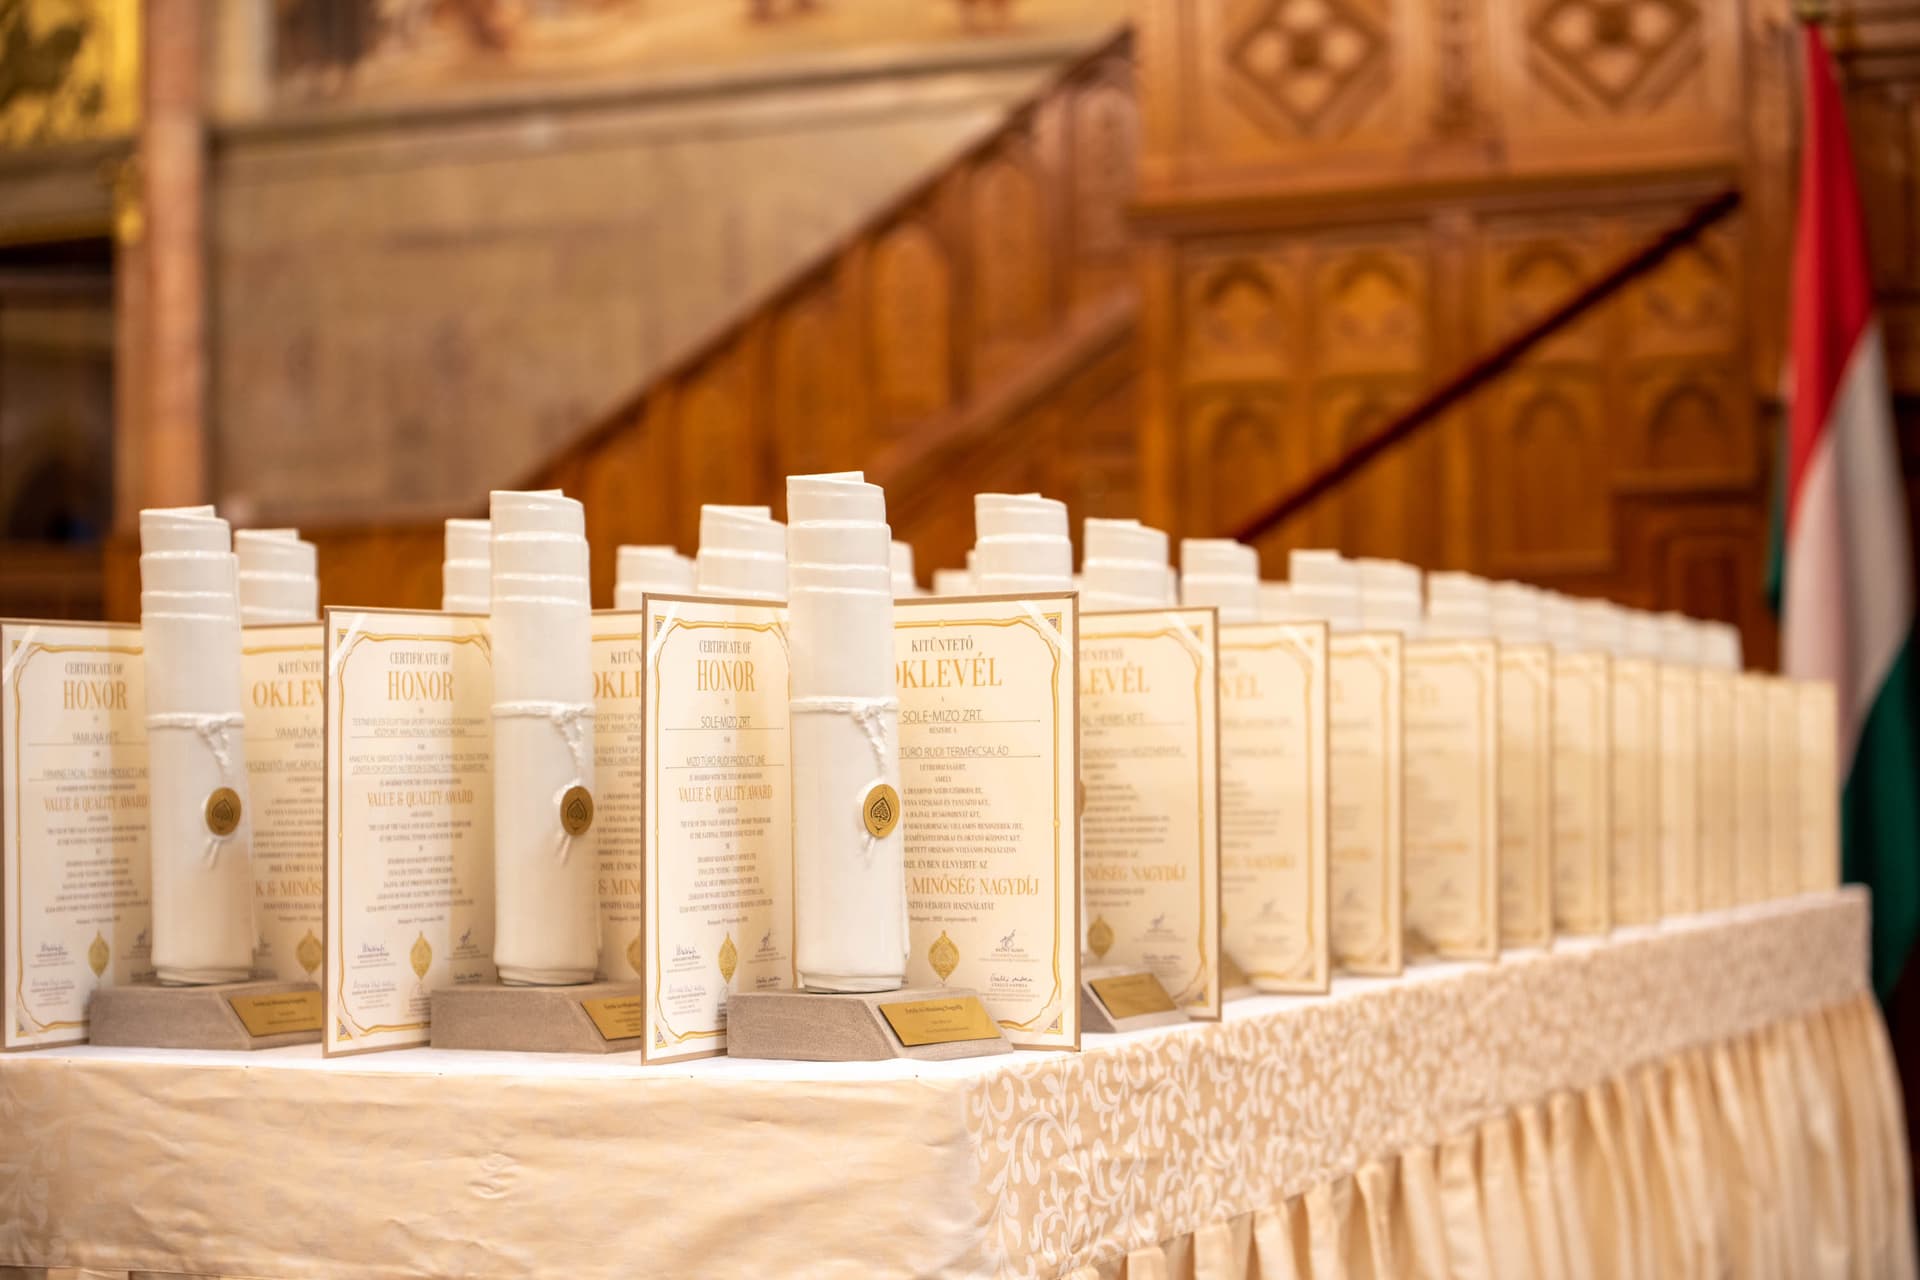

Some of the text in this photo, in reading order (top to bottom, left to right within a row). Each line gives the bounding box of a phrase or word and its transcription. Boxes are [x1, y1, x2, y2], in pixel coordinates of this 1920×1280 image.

[698, 639, 752, 654] CERTIFICATE OF
[390, 652, 449, 665] CERTIFICATE OF
[64, 662, 111, 675] CERTIFICATE
[697, 659, 755, 692] HONOR
[63, 680, 127, 710] HONOR
[387, 671, 455, 701] HONOR
[902, 709, 984, 723] SOLE-MIZO ZRT.
[367, 789, 474, 808] VALUE & QUALITY AWARD
[679, 784, 773, 804] VALUE & QUALITY AWARD
[912, 874, 1040, 895] MINŐSÉG NAGYDÍJ
